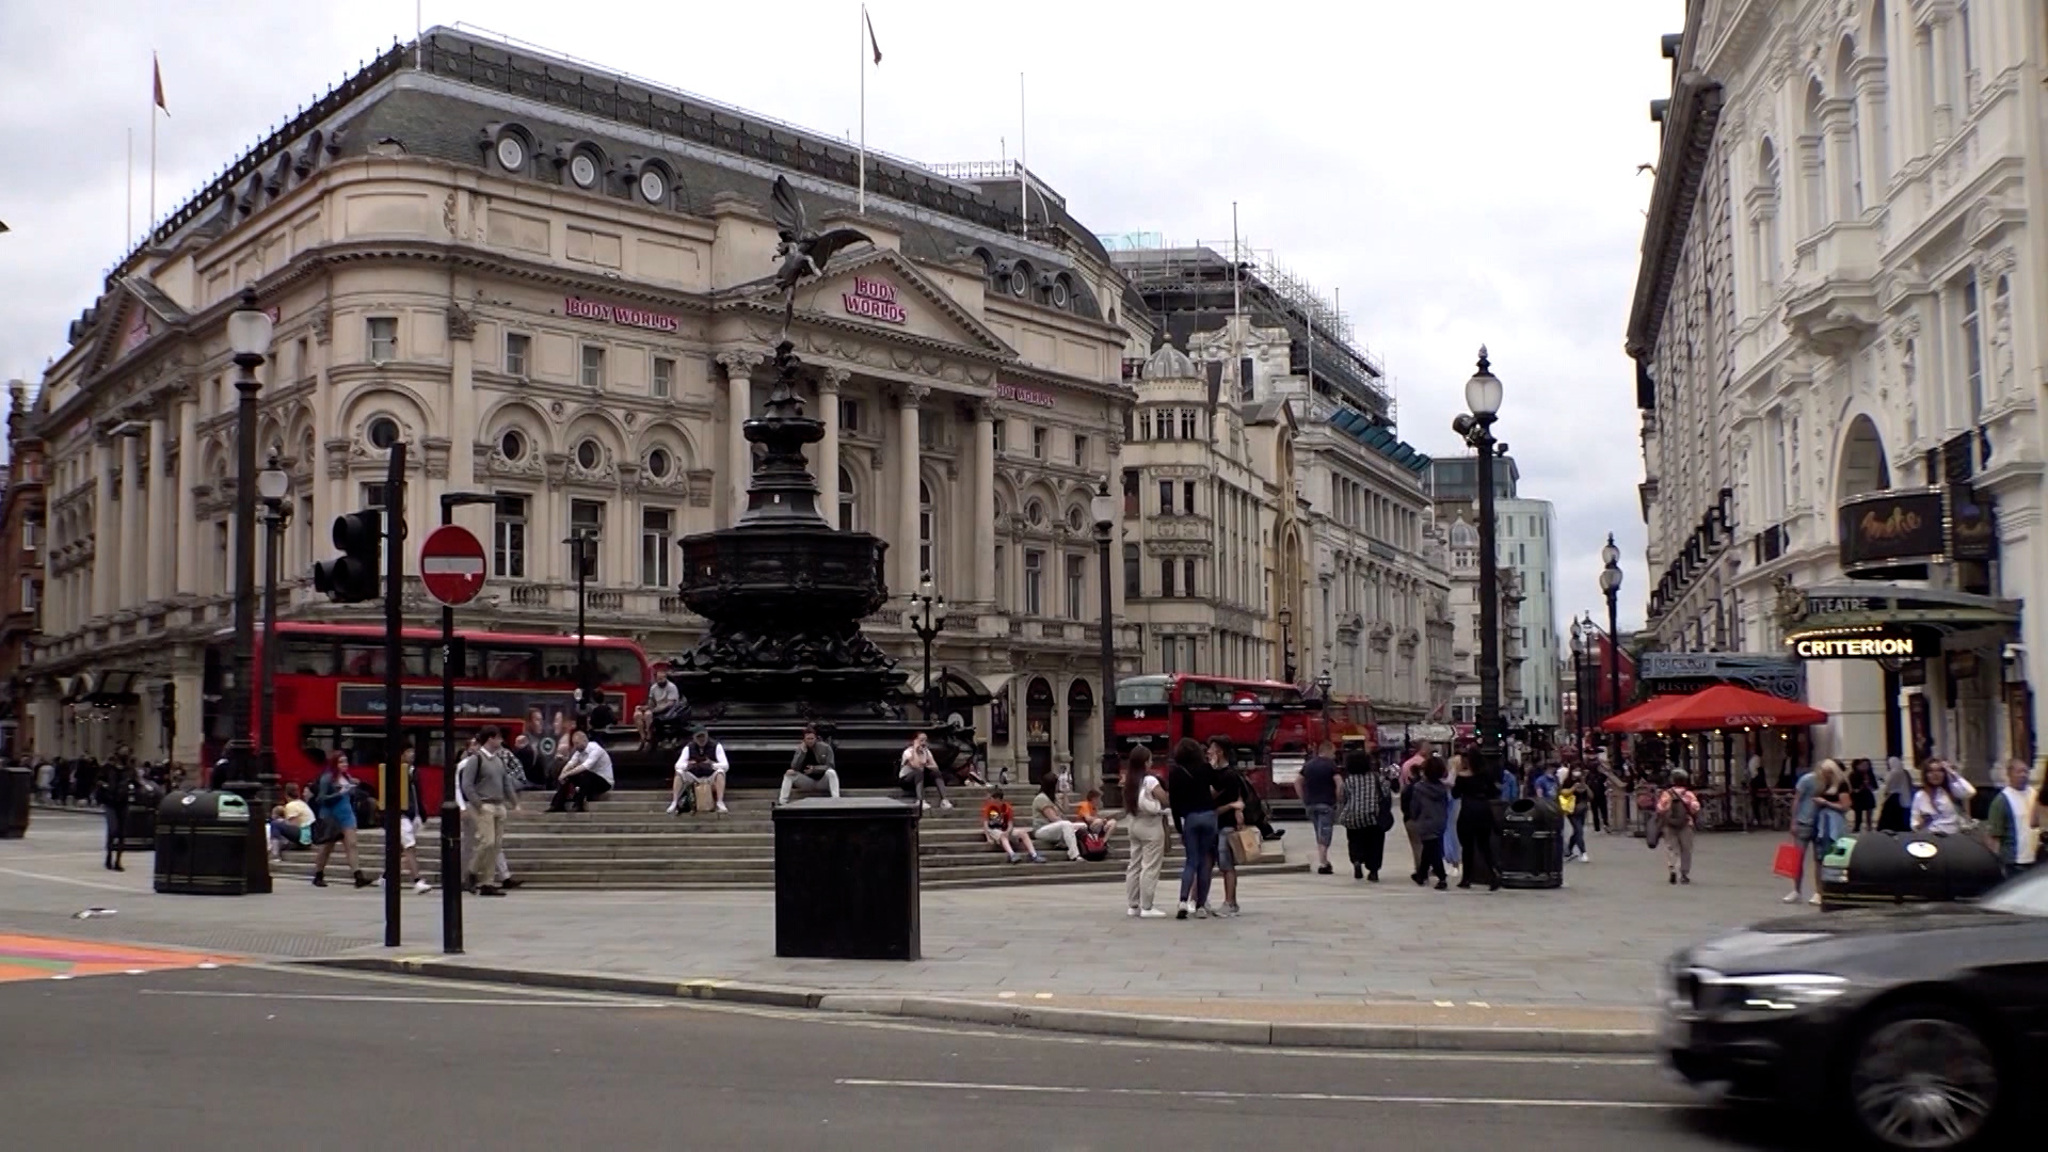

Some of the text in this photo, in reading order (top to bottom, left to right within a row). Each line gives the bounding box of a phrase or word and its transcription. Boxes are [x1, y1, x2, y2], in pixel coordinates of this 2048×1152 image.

[854, 277, 899, 304] BODY
[565, 298, 680, 334] BODY WORLDS
[842, 293, 907, 326] WORLDS
[996, 384, 1016, 401] ODY
[1809, 598, 1870, 613] THEATRE
[1797, 638, 1913, 657] CRITERION
[1133, 709, 1146, 719] 94
